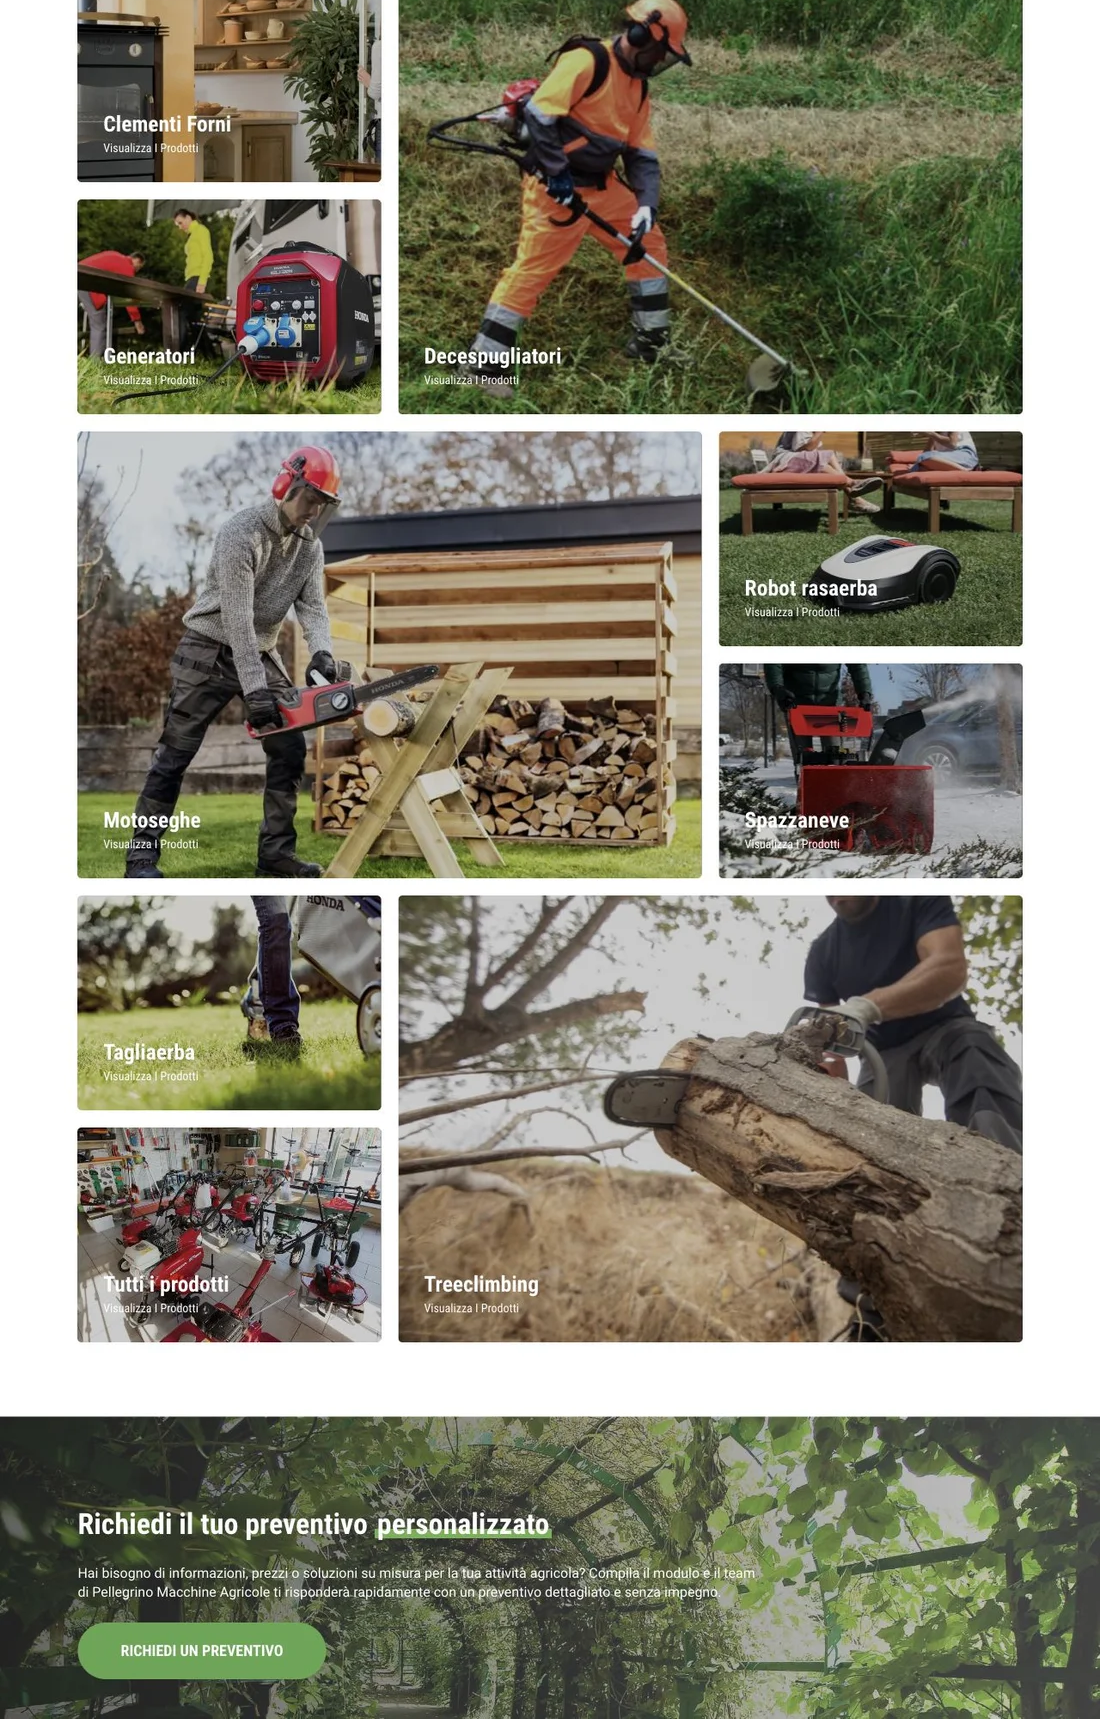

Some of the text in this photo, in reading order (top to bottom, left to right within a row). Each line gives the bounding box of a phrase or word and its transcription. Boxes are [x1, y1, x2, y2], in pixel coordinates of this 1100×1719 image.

[104, 115, 230, 132] Clementi Forni
[104, 347, 194, 364] Generatori
[425, 347, 561, 368] Decespugliatori
[745, 578, 877, 596] Robot rasaerba
[371, 680, 405, 694] HONDA
[104, 812, 199, 831] Motoseghe
[745, 811, 849, 833] Spazzaneve
[307, 895, 345, 912] HONDA
[104, 1043, 195, 1063] Tagliaerba
[103, 1275, 228, 1297] Tutti i prodotti
[424, 1275, 538, 1296] Treeclimbing
[425, 1303, 473, 1313] Visualizza
[481, 1303, 520, 1313] Prodotti
[79, 1512, 549, 1541] Richiedi il tuo preventivo personalizzato
[79, 1586, 721, 1600] di Pellegrino Macchine Agricole ti risponderà rapidamente con un preventivo dettagliato e senza impegno.
